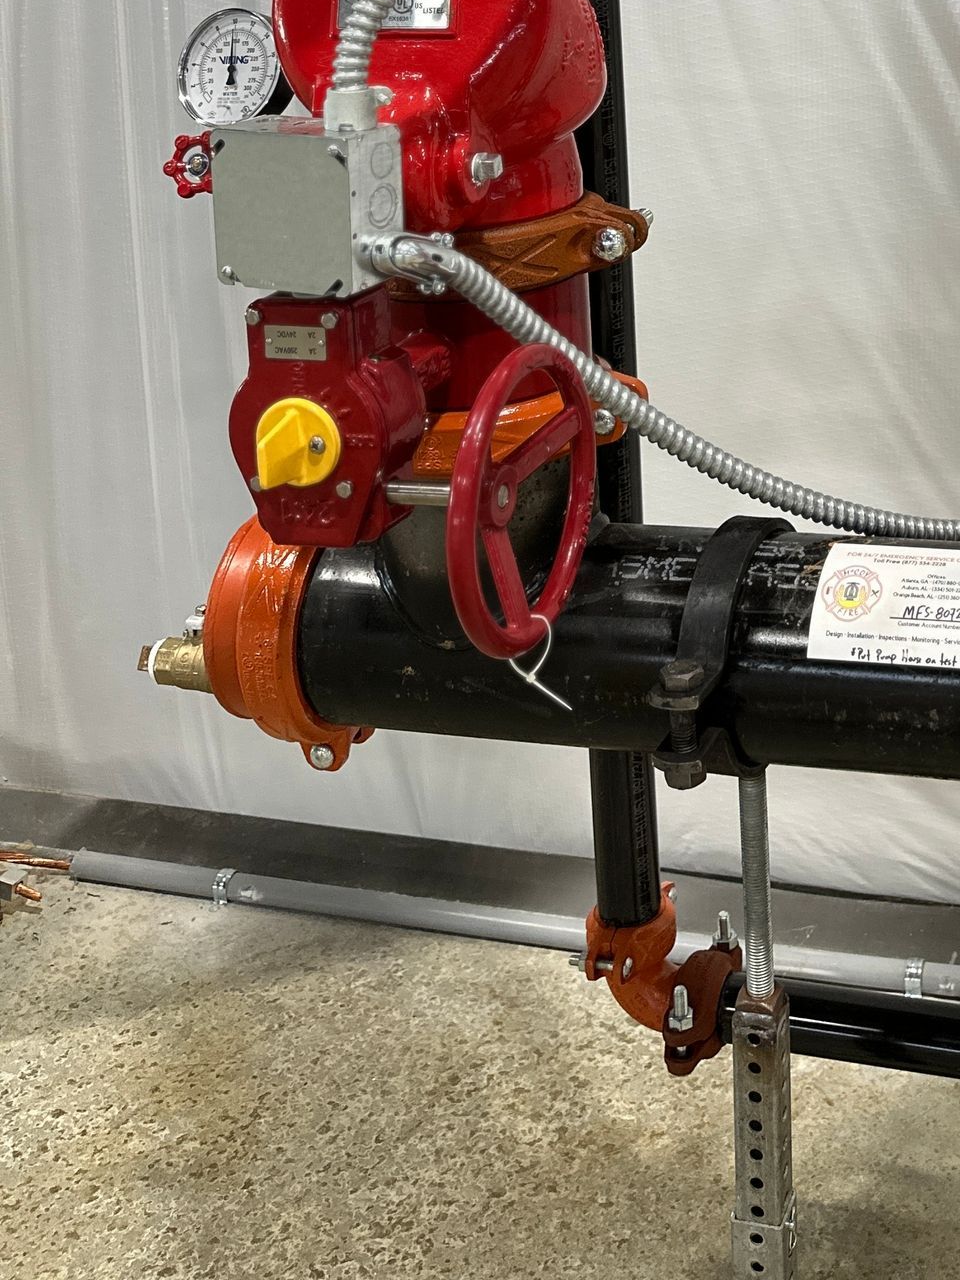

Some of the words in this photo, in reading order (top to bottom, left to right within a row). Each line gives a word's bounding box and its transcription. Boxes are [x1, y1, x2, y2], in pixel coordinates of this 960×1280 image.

[219, 55, 249, 64] VIKING
[612, 334, 626, 358] ASTM
[879, 634, 907, 642] Inspections
[911, 637, 940, 645] Monitoring
[876, 649, 896, 664] Pump
[902, 649, 921, 663] House
[940, 653, 957, 666] test
